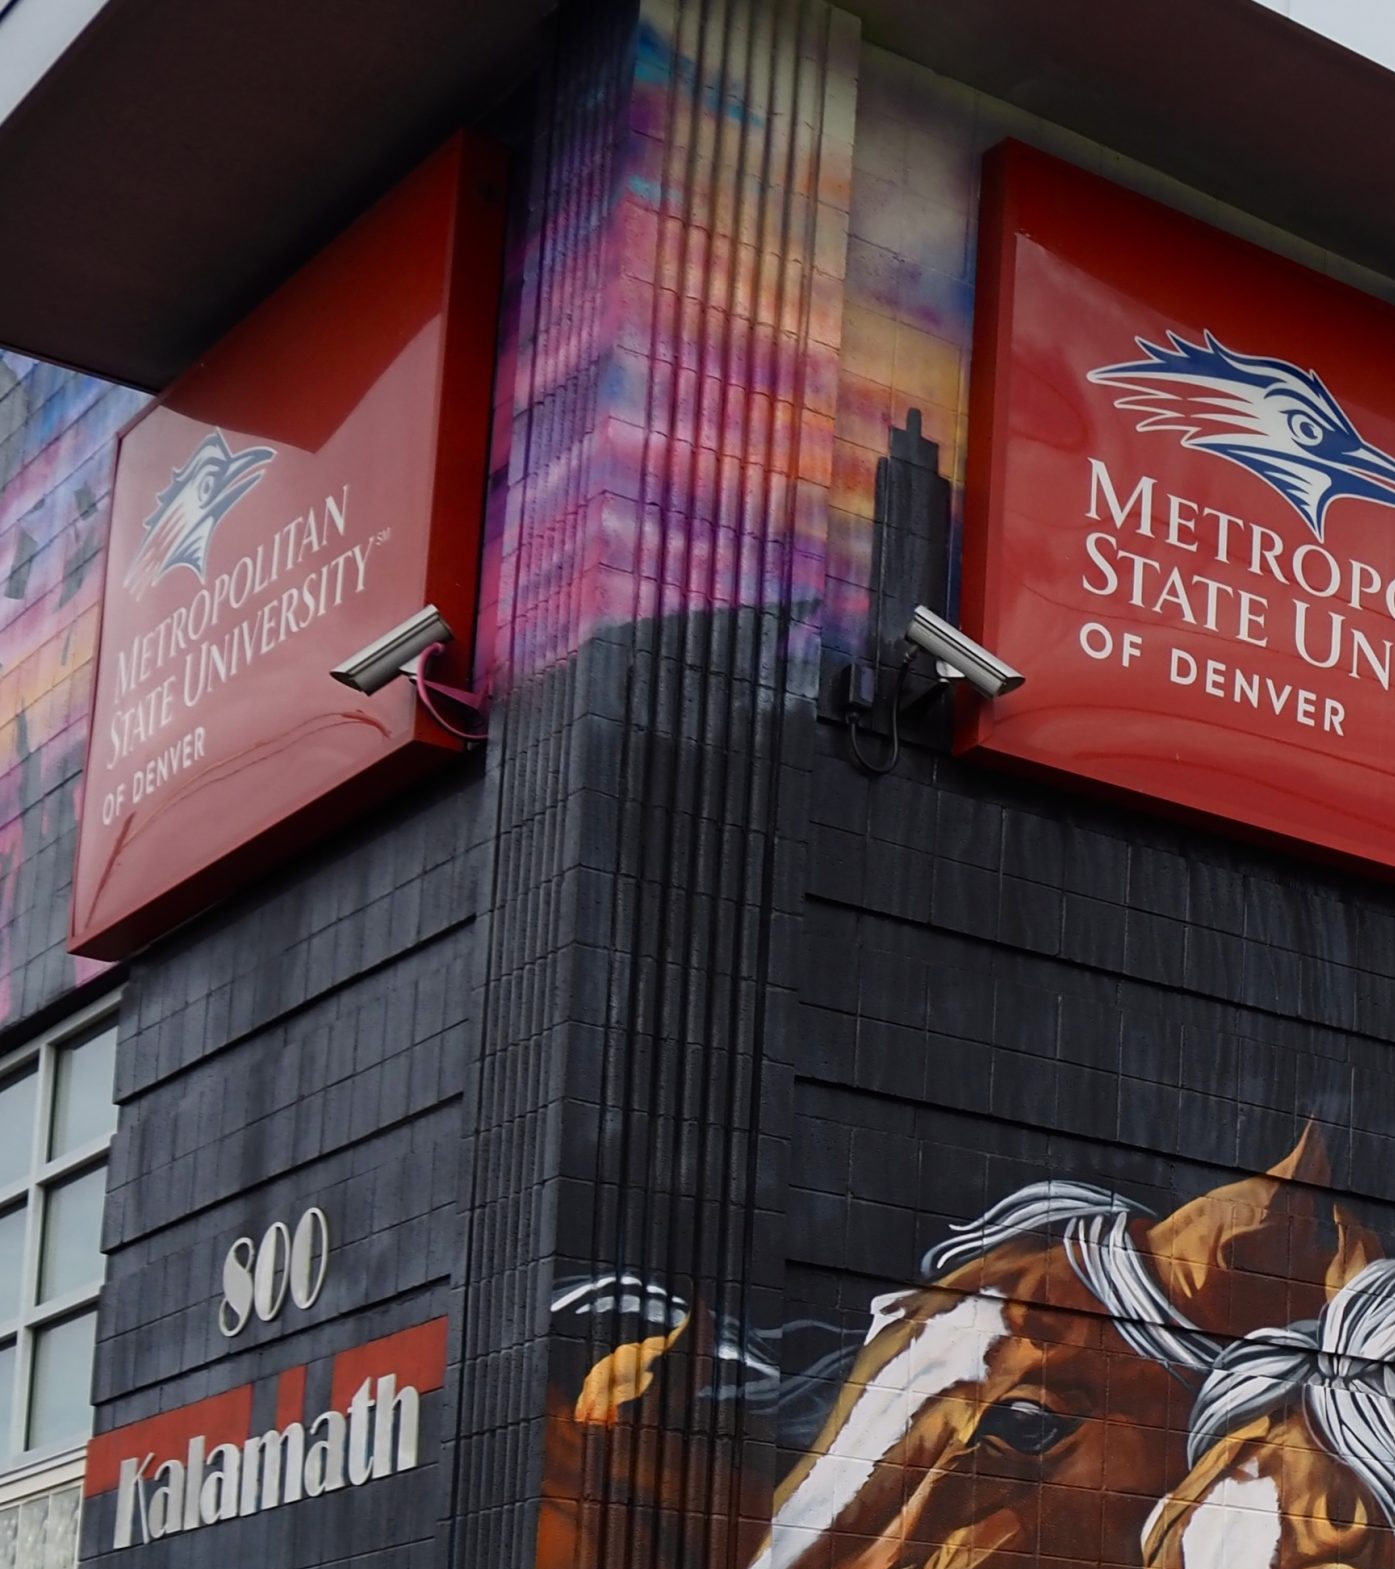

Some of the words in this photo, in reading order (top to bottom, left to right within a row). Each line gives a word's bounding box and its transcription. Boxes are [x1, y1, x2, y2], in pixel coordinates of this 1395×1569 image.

[107, 674, 176, 770] STATE
[184, 536, 376, 708] UNIVERSITY
[115, 485, 349, 698] METROPOLITAN
[1082, 532, 1269, 648] STATE
[1079, 622, 1142, 668] OF
[1170, 648, 1347, 736] DENVER
[102, 792, 126, 826] OF
[132, 725, 206, 805] DENVER
[218, 1206, 329, 1338] 800
[113, 1372, 420, 1550] Kalamath
